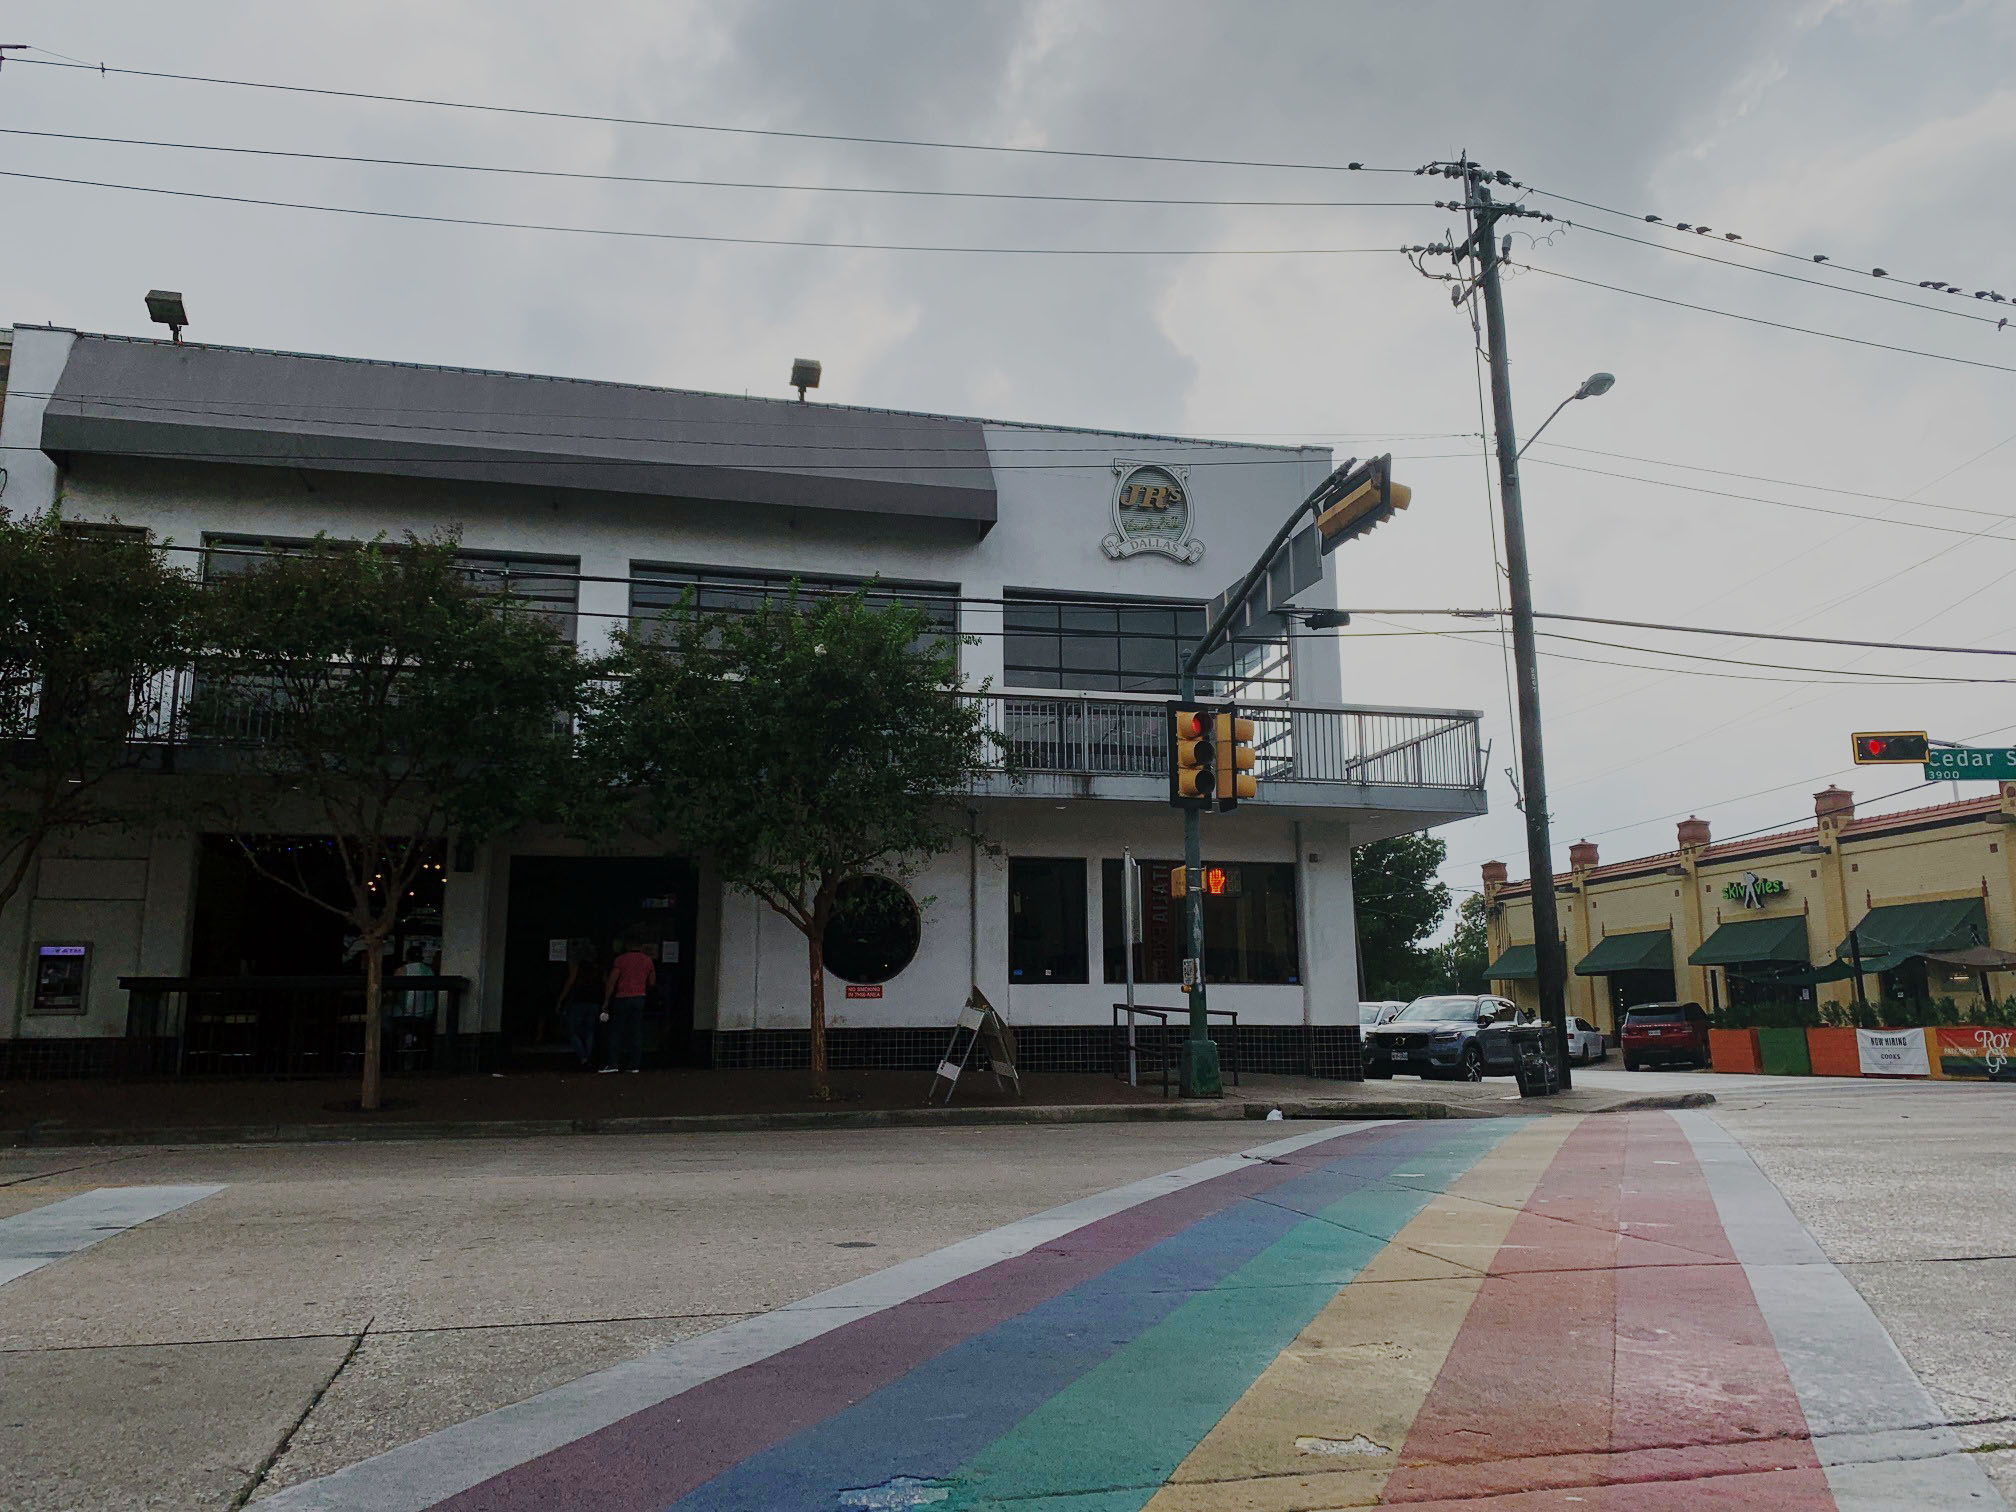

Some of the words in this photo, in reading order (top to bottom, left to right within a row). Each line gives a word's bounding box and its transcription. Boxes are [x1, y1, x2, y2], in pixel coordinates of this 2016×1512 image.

[1130, 538, 1180, 553] DALLAS
[1929, 750, 1994, 767] Cedar
[1928, 770, 1960, 780] 3900
[1870, 1037, 1884, 1046] NOW
[1885, 1037, 1907, 1047] HIRING
[1974, 1030, 2013, 1049] ROY
